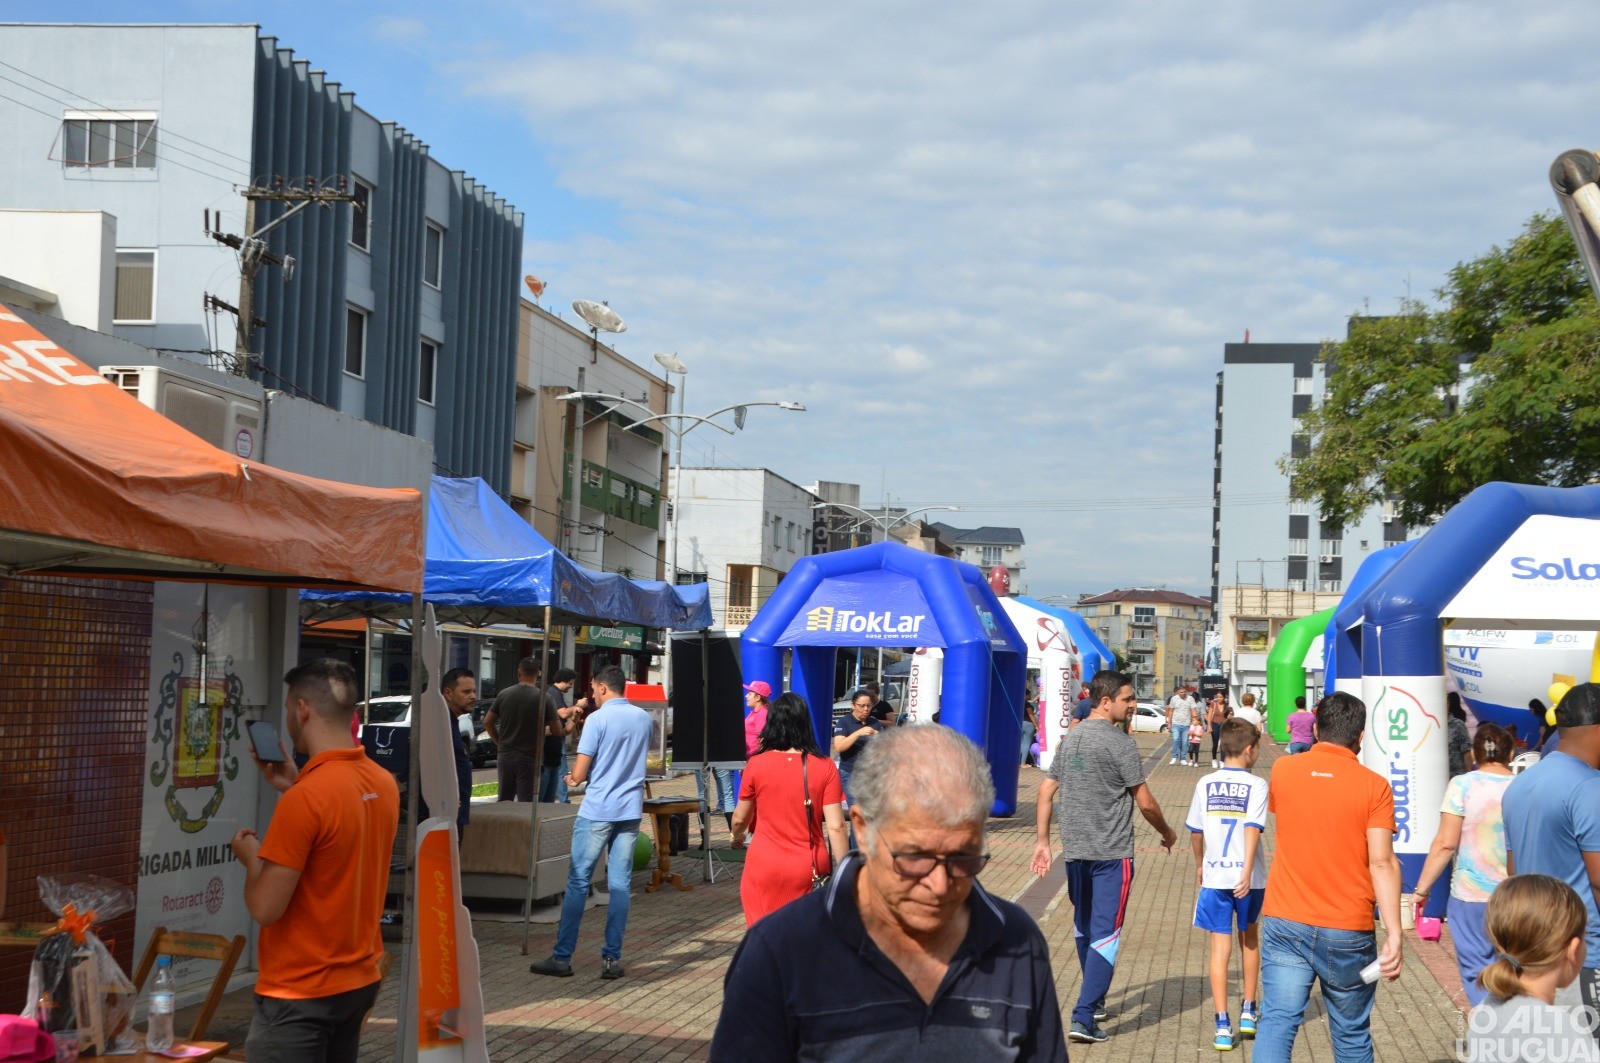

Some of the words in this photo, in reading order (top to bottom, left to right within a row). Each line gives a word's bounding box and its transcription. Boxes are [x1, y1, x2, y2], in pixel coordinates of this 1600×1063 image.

[838, 610, 926, 633] TokLar
[1556, 634, 1579, 643] CDL
[1059, 667, 1070, 729] Credisol
[1388, 708, 1408, 741] RS
[1208, 782, 1249, 798] AABB
[1220, 818, 1238, 857] 7
[433, 870, 446, 903] em
[162, 891, 204, 913] Rotaract
